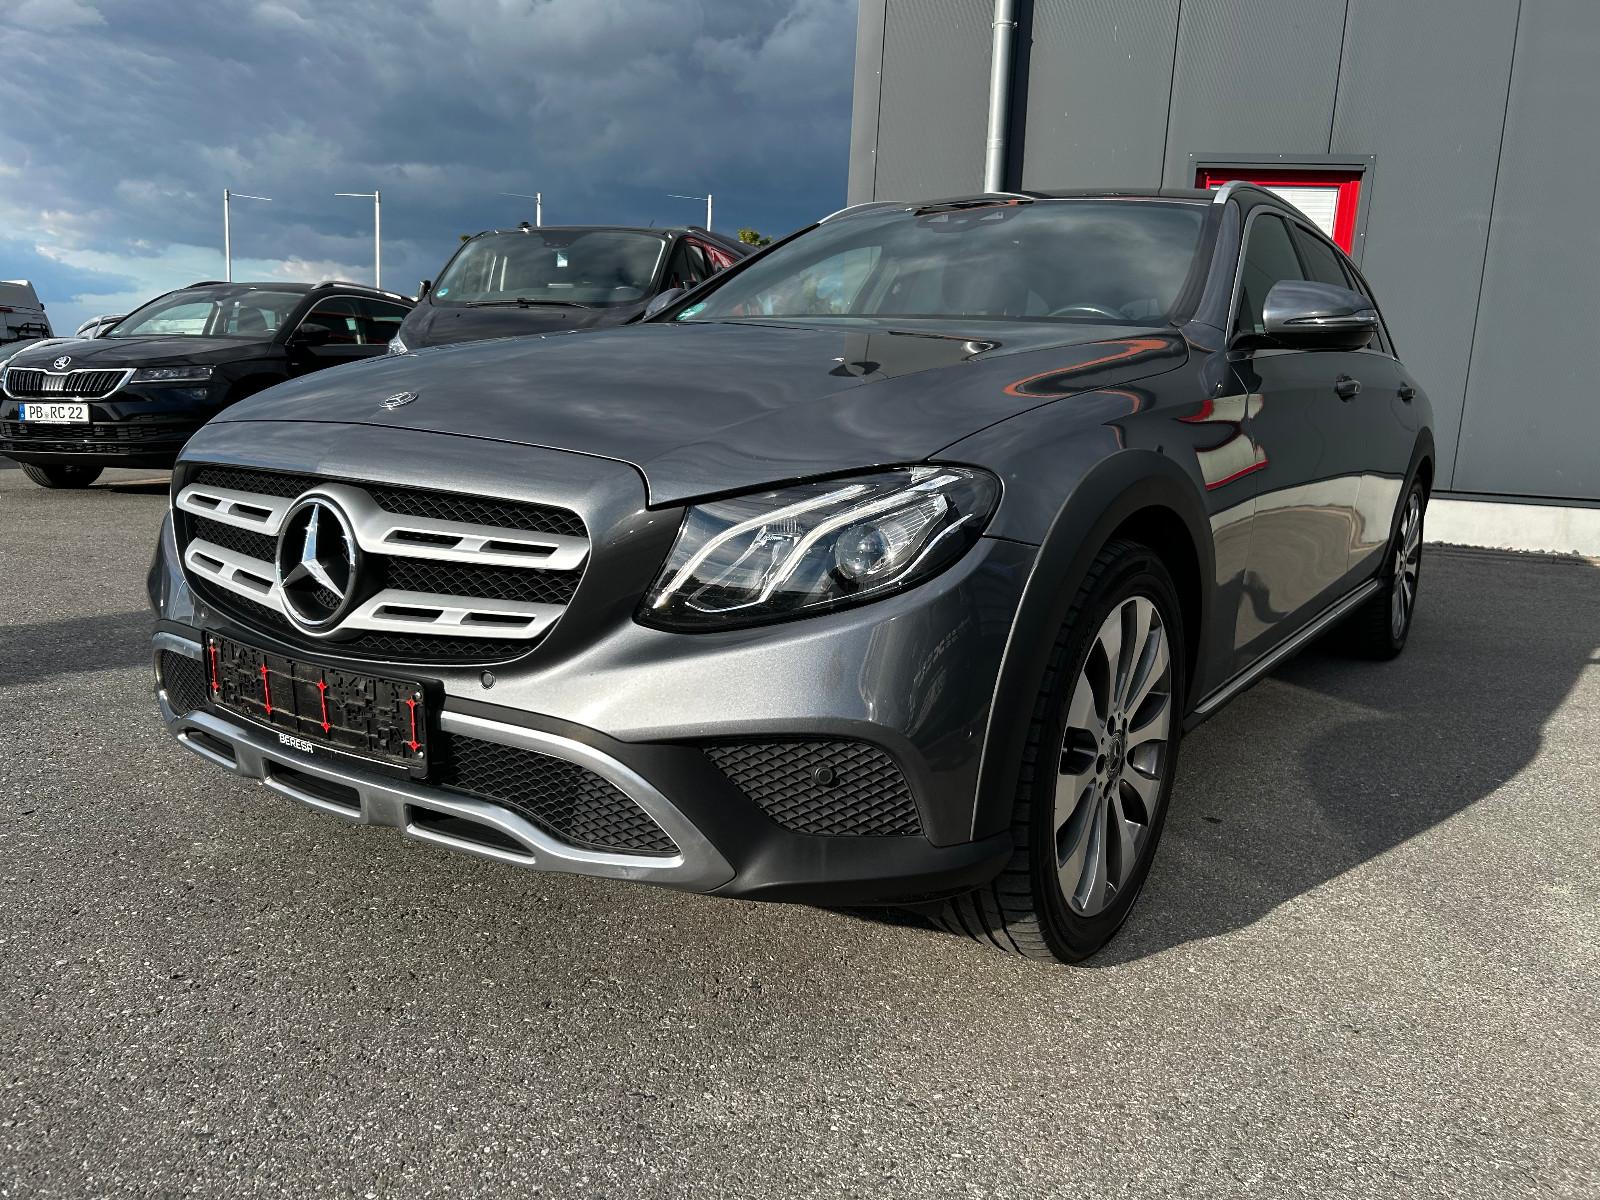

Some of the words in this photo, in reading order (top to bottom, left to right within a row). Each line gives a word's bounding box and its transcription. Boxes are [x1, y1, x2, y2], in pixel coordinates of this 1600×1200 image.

[29, 405, 43, 419] PB
[50, 406, 66, 419] RC
[68, 406, 84, 420] 22
[279, 732, 314, 754] BERESA
